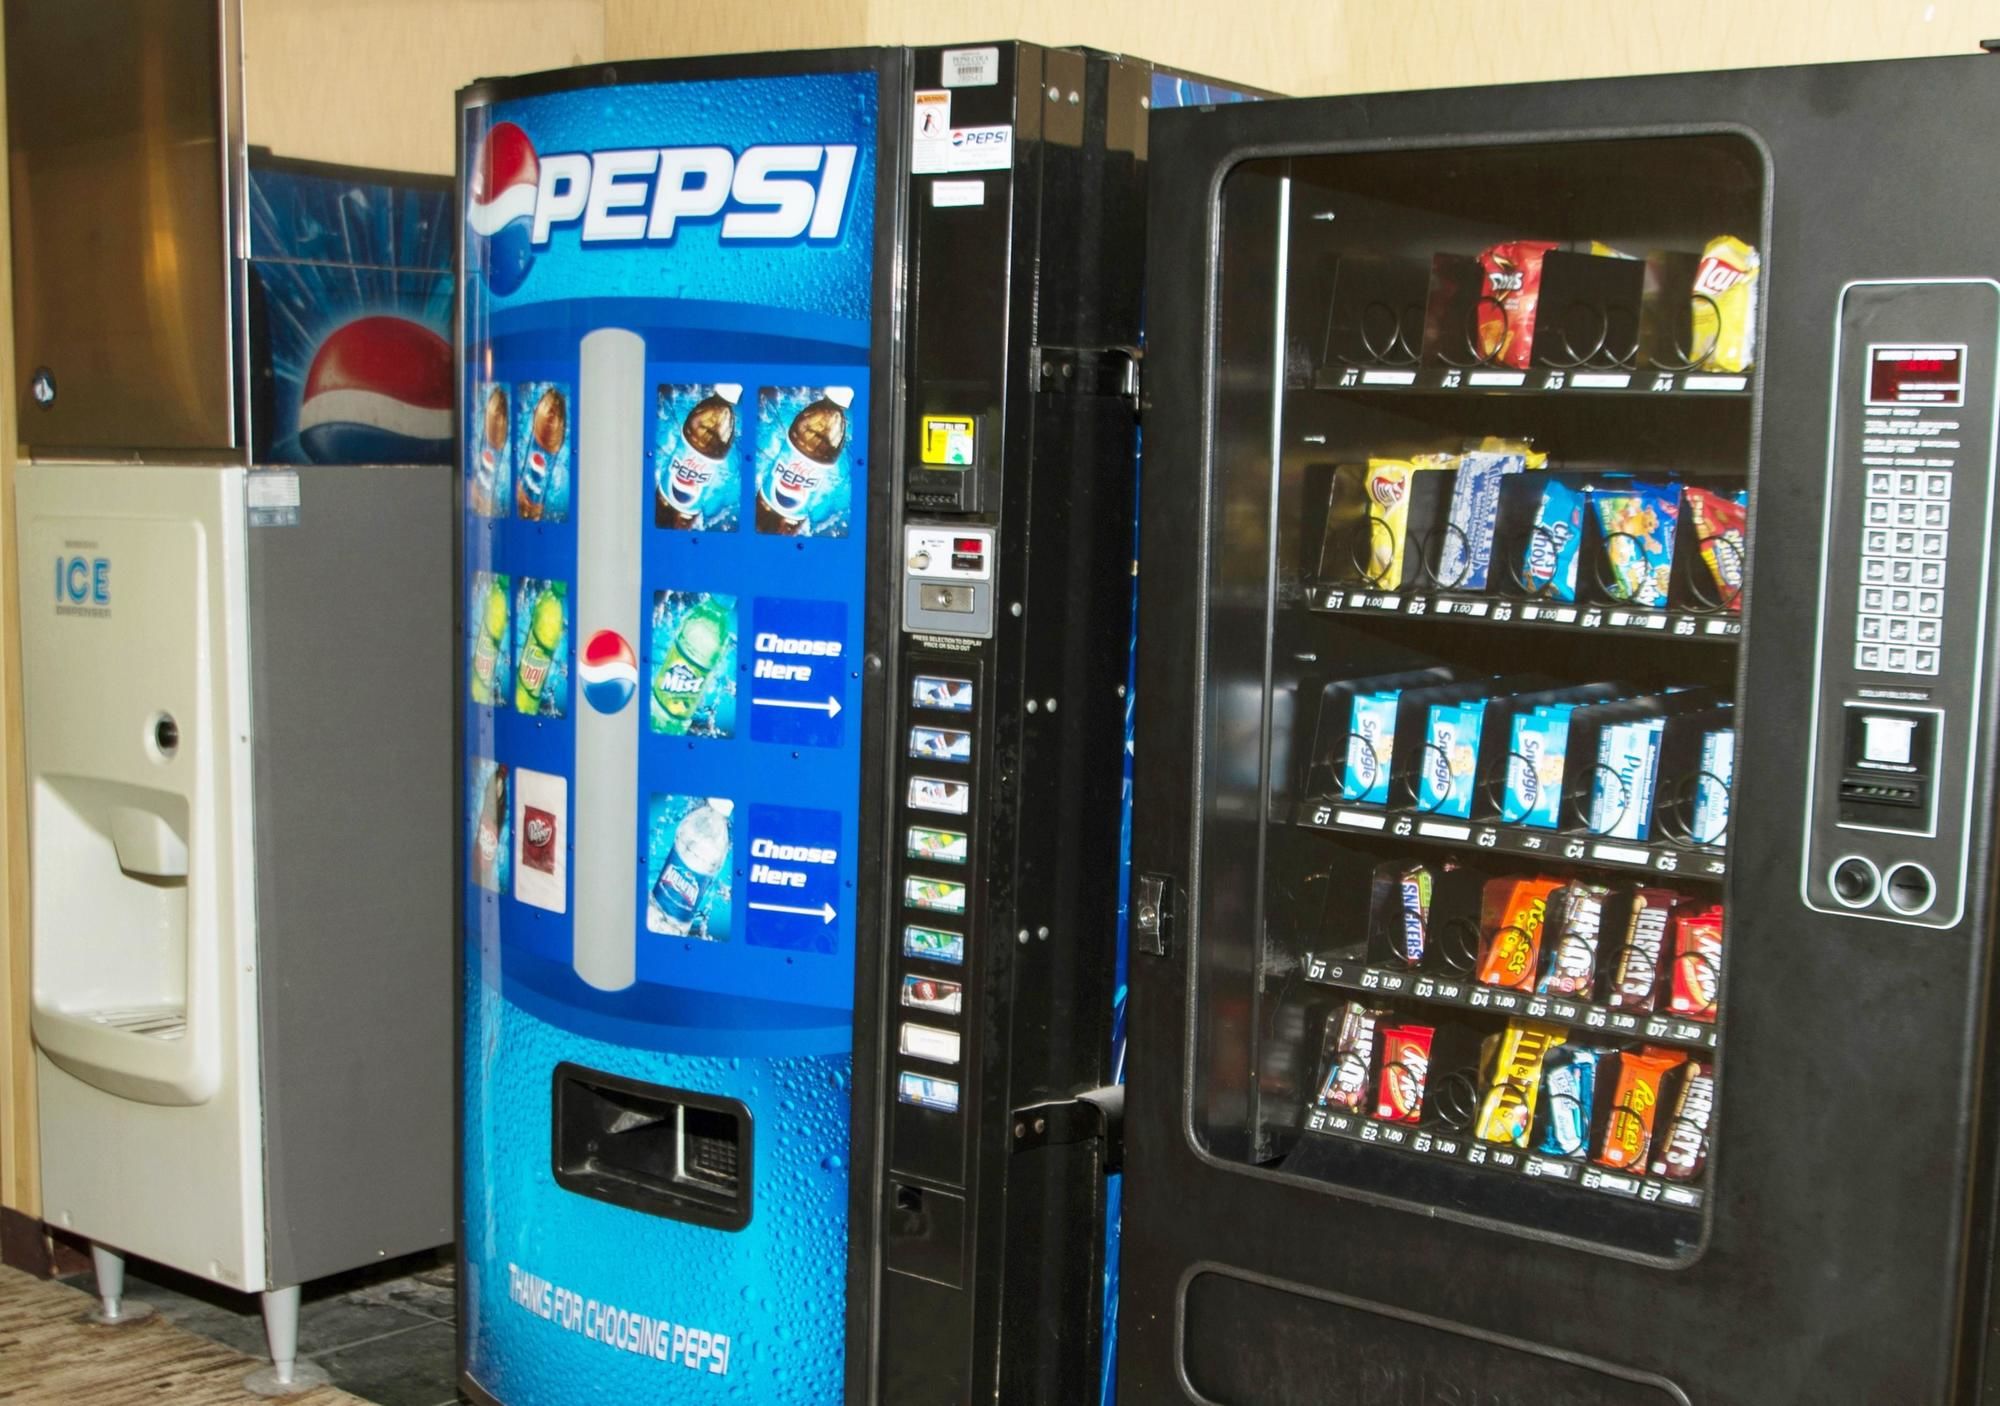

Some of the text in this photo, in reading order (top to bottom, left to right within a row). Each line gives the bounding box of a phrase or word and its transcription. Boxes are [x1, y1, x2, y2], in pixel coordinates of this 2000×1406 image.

[966, 131, 1008, 145] PEPSI
[531, 144, 858, 244] PEPSI
[1340, 375, 1358, 386] A1
[1441, 375, 1461, 388] A2
[1544, 377, 1564, 389] A3
[1652, 379, 1673, 391] A4
[55, 556, 111, 605] ICE
[1326, 597, 1382, 608] B1 1.00
[1408, 602, 1470, 614] B2 1.00
[1493, 608, 1556, 620] B3 1.00
[1582, 614, 1647, 627] B4 1.00
[1674, 622, 1741, 635] B5 1.0
[755, 632, 842, 657] Choose
[929, 635, 955, 643] SELECTION
[754, 659, 812, 682] Here
[1314, 812, 1330, 825] C1
[1395, 822, 1412, 836] C2
[1479, 833, 1496, 846] C3
[751, 838, 837, 864] Choose
[1565, 844, 1584, 858] C4
[1656, 858, 1677, 871] C5
[750, 864, 807, 887] Here
[1310, 966, 1325, 979] D1
[1362, 975, 1401, 988] D2 1.00
[1416, 984, 1458, 997] D3 1.00
[1471, 993, 1516, 1007] D4 1.00
[1528, 1003, 1575, 1018] D5 1.00
[1587, 1013, 1635, 1028] D6 1.00
[1648, 1023, 1700, 1038] D7 1.00
[1310, 1117, 1347, 1129] E1 1.00
[1361, 1128, 1403, 1142] E2 1.00
[1415, 1139, 1456, 1153] E3 1.00
[1469, 1151, 1514, 1165] E4 1.00
[1524, 1162, 1541, 1175] E5
[1582, 1175, 1600, 1187] E6
[1641, 1188, 1661, 1201] E7
[508, 1262, 731, 1375] THANKS FOR CHOOSING PEPSI
